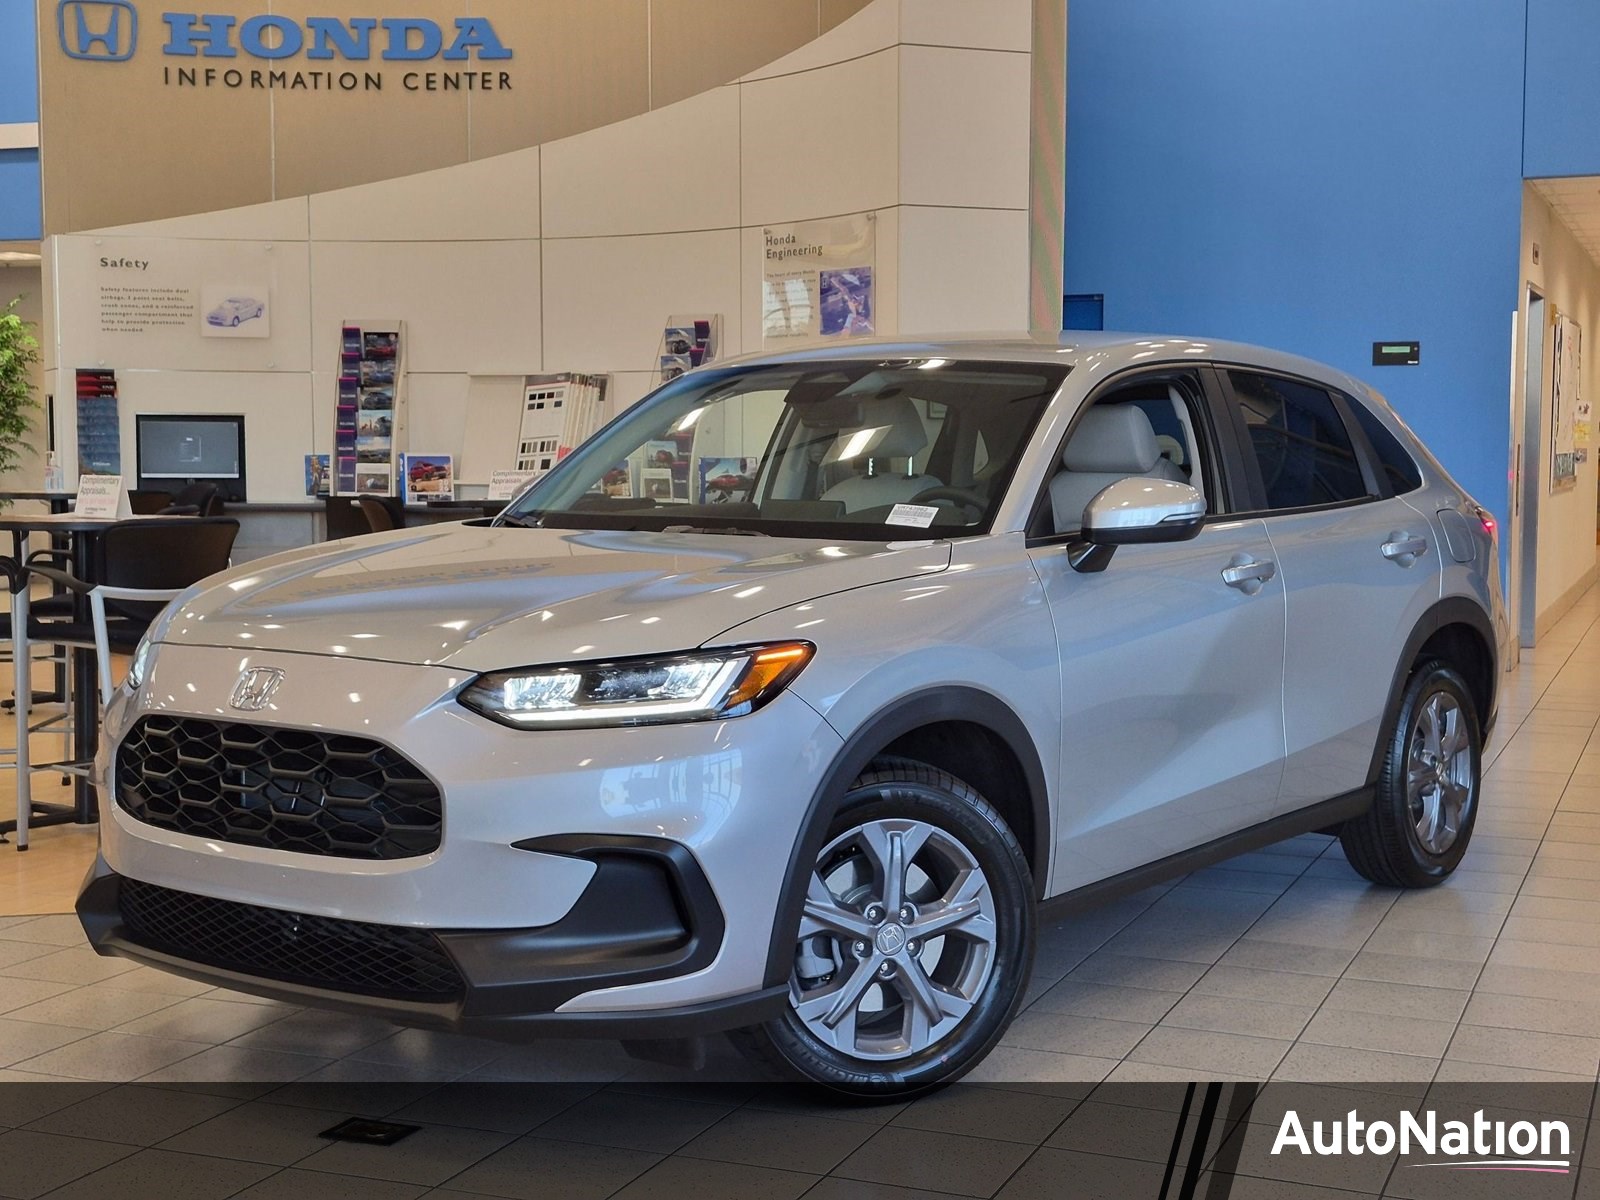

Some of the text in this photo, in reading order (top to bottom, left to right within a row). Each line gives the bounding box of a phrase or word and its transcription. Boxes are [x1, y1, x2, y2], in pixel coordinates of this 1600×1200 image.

[162, 13, 513, 61] HONDA
[163, 66, 513, 91] INFORMATION CENTER
[765, 233, 796, 247] Honda
[766, 244, 823, 261] Engineering
[100, 257, 149, 271] Safety
[82, 476, 120, 487] Complimentary
